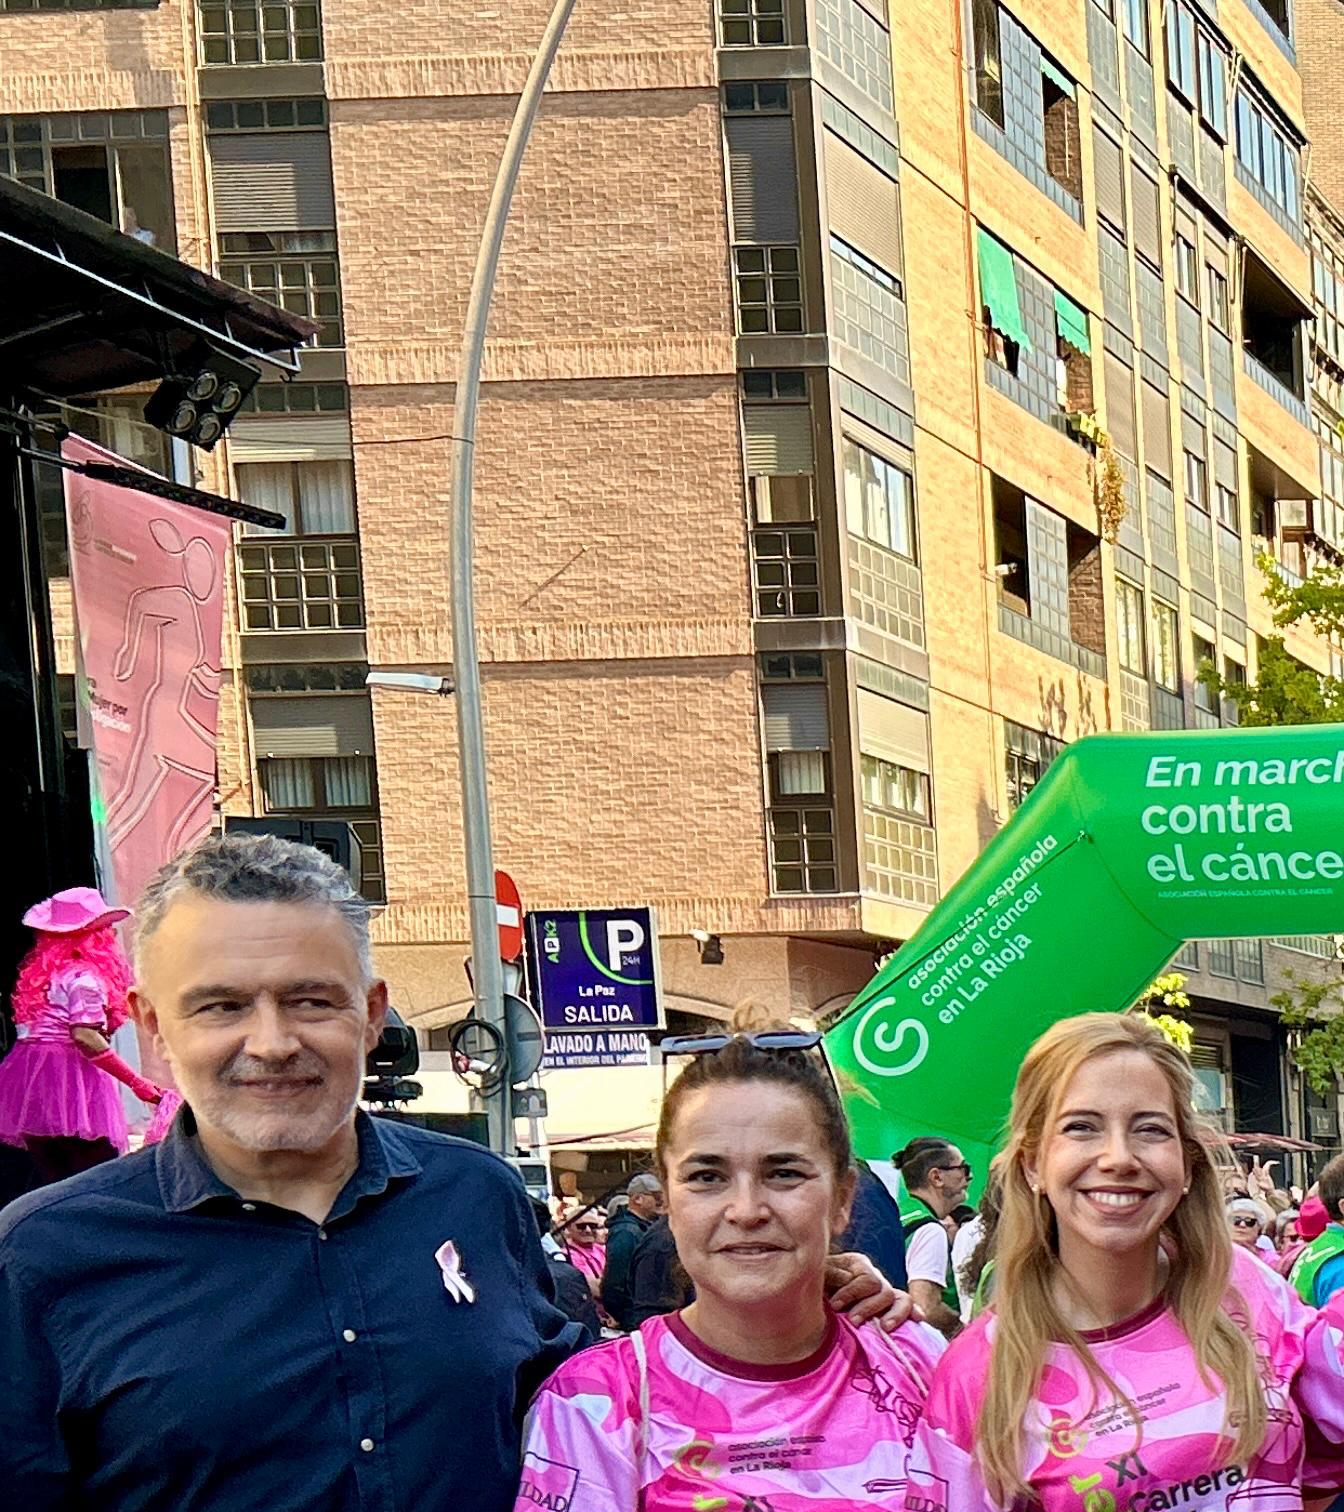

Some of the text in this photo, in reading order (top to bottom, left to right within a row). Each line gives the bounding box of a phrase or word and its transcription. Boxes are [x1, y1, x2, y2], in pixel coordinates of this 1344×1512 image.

[1145, 755, 1202, 788] En
[1141, 795, 1293, 836] contra
[1147, 843, 1195, 883] el
[908, 834, 1059, 990] asociación española
[606, 919, 645, 972] P
[921, 882, 1044, 1007] contra el cáncer
[578, 984, 616, 998] La Paz
[938, 932, 1033, 1025] en La Rioja
[564, 1004, 634, 1024] SALIDA
[543, 1032, 648, 1055] LAVADO A MANO
[746, 1463, 760, 1472] La
[1104, 1450, 1149, 1488] XI
